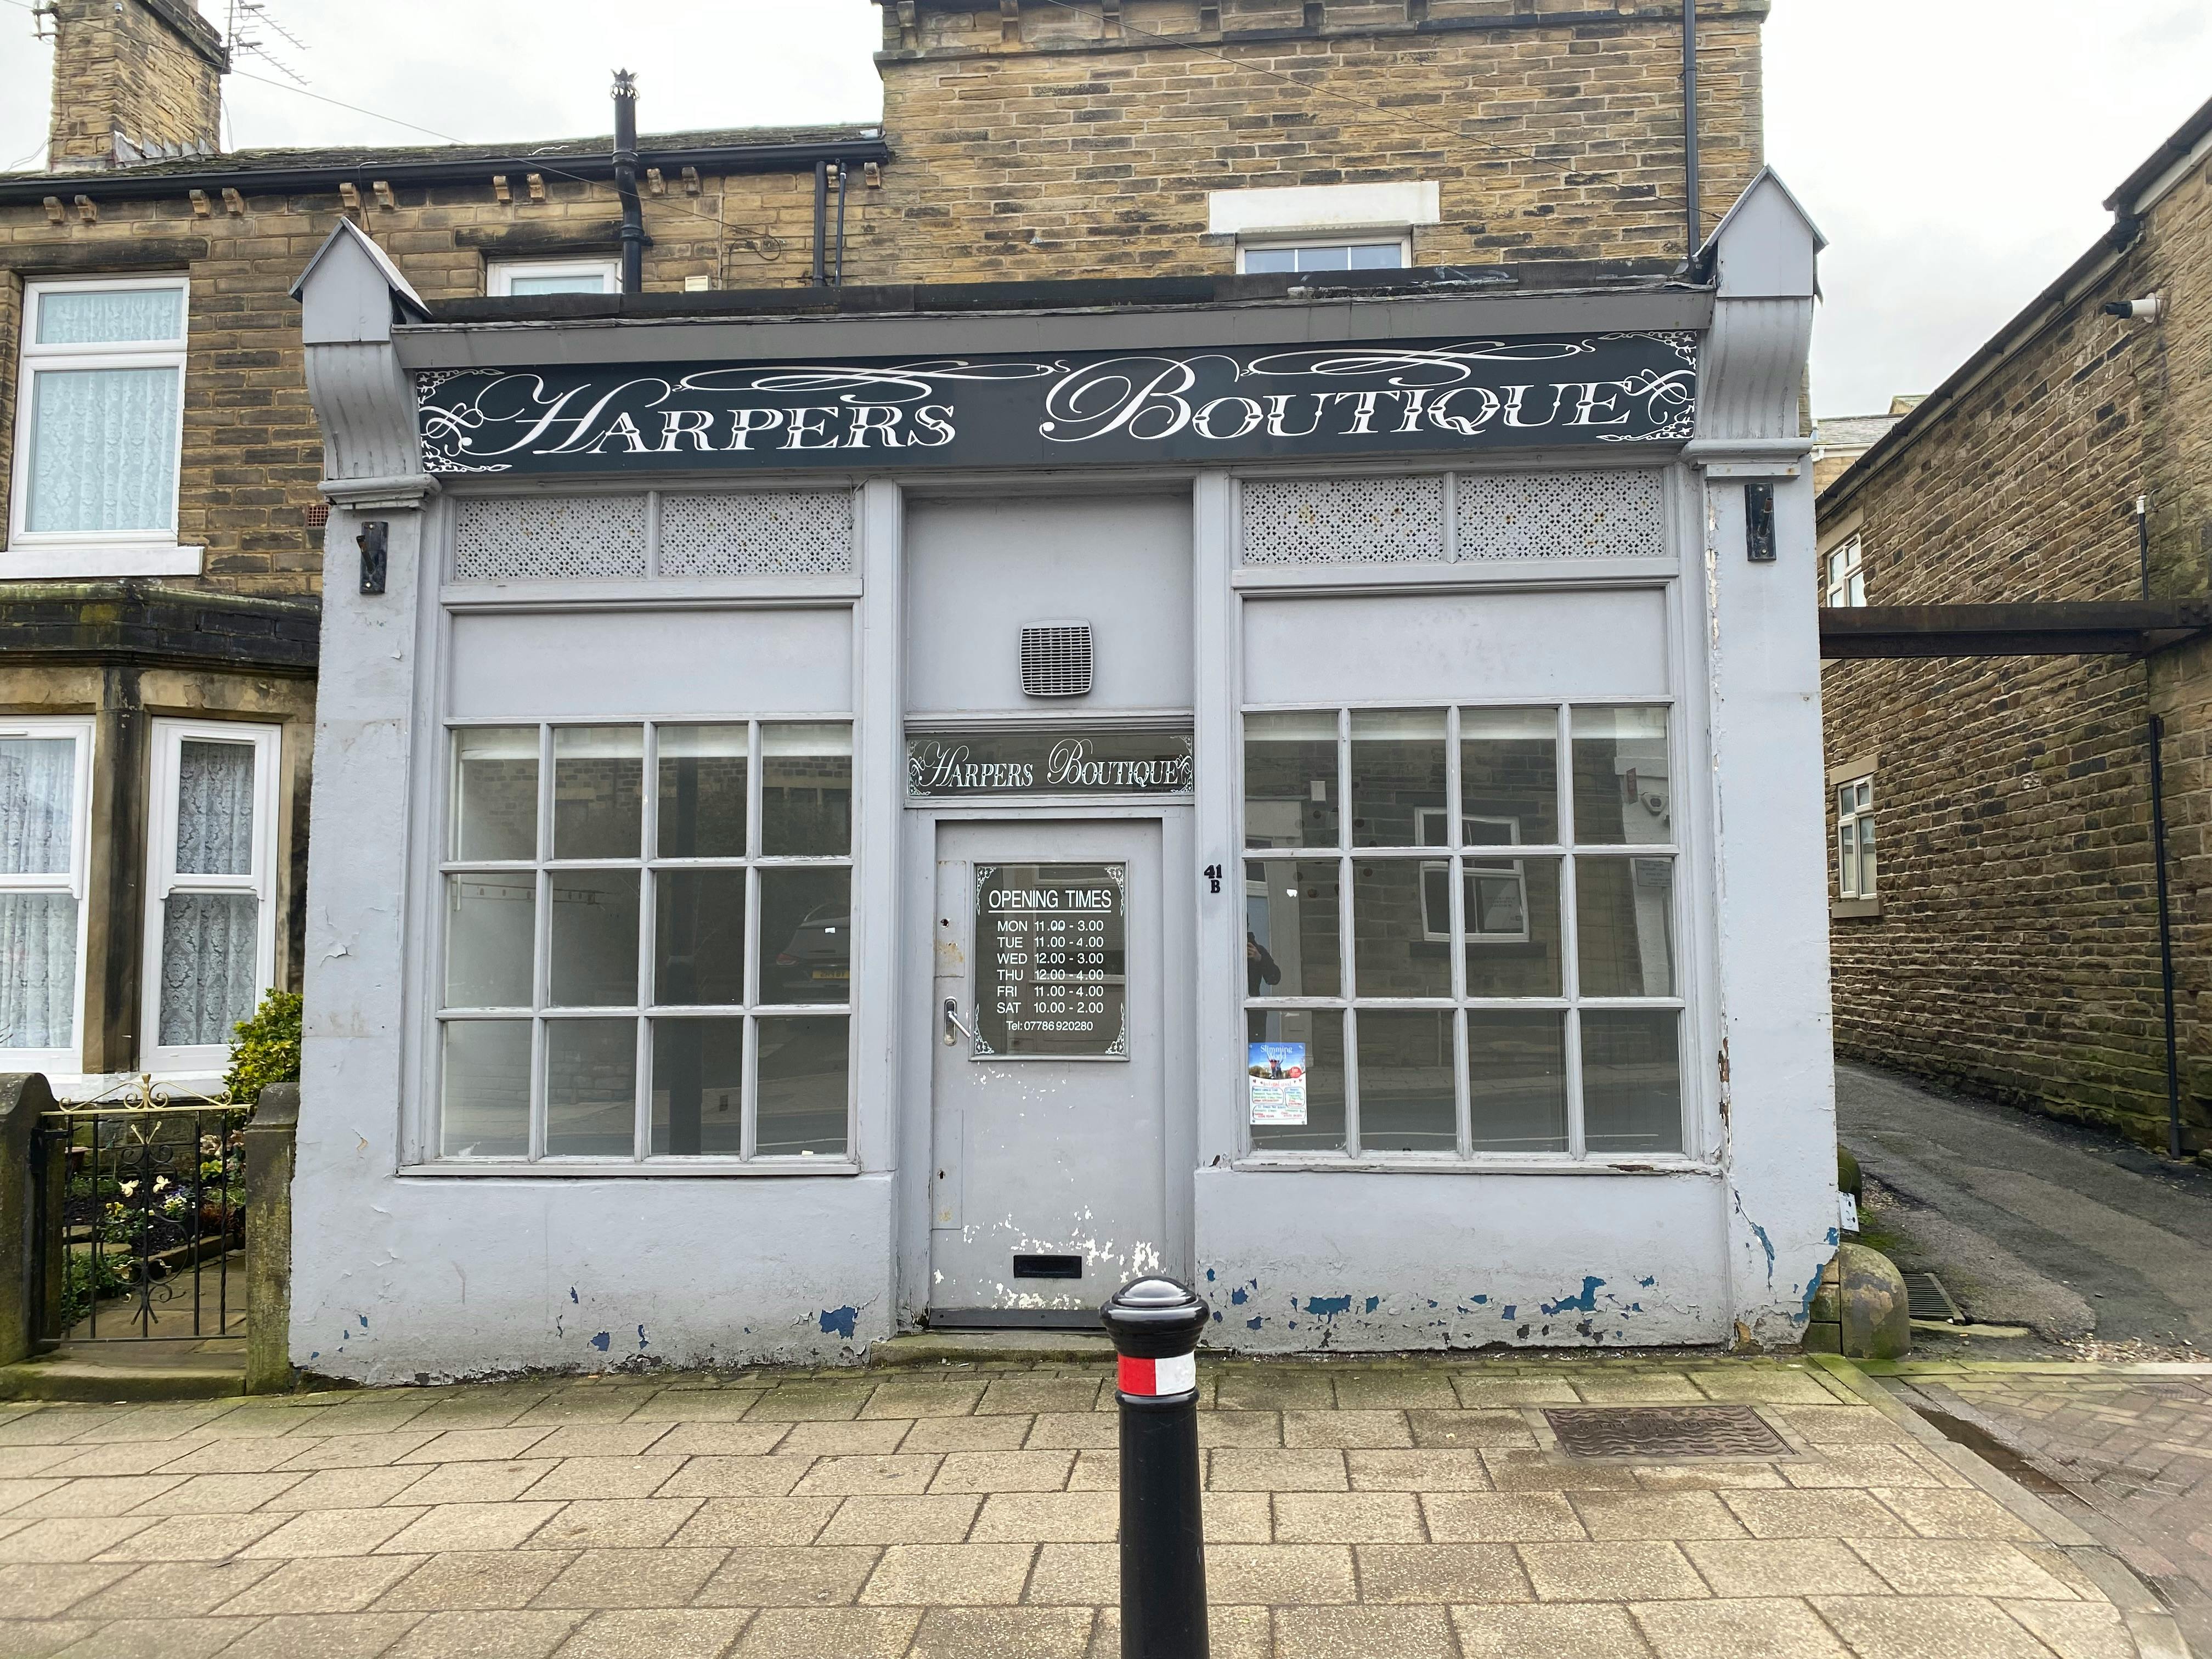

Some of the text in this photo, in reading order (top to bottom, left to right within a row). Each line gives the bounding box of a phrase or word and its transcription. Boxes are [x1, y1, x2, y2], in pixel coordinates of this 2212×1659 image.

[1204, 864, 1222, 879] 41
[1210, 879, 1221, 894] B
[989, 889, 1112, 909] OPENING TIMES
[996, 920, 1028, 932] MON
[1034, 920, 1066, 932] 11.00
[1077, 920, 1104, 932] 3.00
[996, 936, 1023, 948] TUE
[1034, 936, 1066, 947] 11.00
[1076, 936, 1104, 947] 4.00
[996, 952, 1028, 964] WED
[1034, 952, 1066, 964] 12.00
[1077, 952, 1104, 964] 3.00
[996, 969, 1024, 981] THU
[1034, 969, 1066, 980] 12.00
[1076, 969, 1104, 980] 4.00
[996, 985, 1018, 997] FRI
[1034, 985, 1066, 997] 11.00
[1076, 985, 1104, 997] 4.00
[996, 1002, 1022, 1014] SAT
[1034, 1002, 1066, 1013] 10.00
[1077, 1002, 1104, 1013] 2.00
[1024, 1021, 1054, 1031] 07786
[1056, 1021, 1093, 1031] 920280
[1260, 1045, 1293, 1053] Slimming
